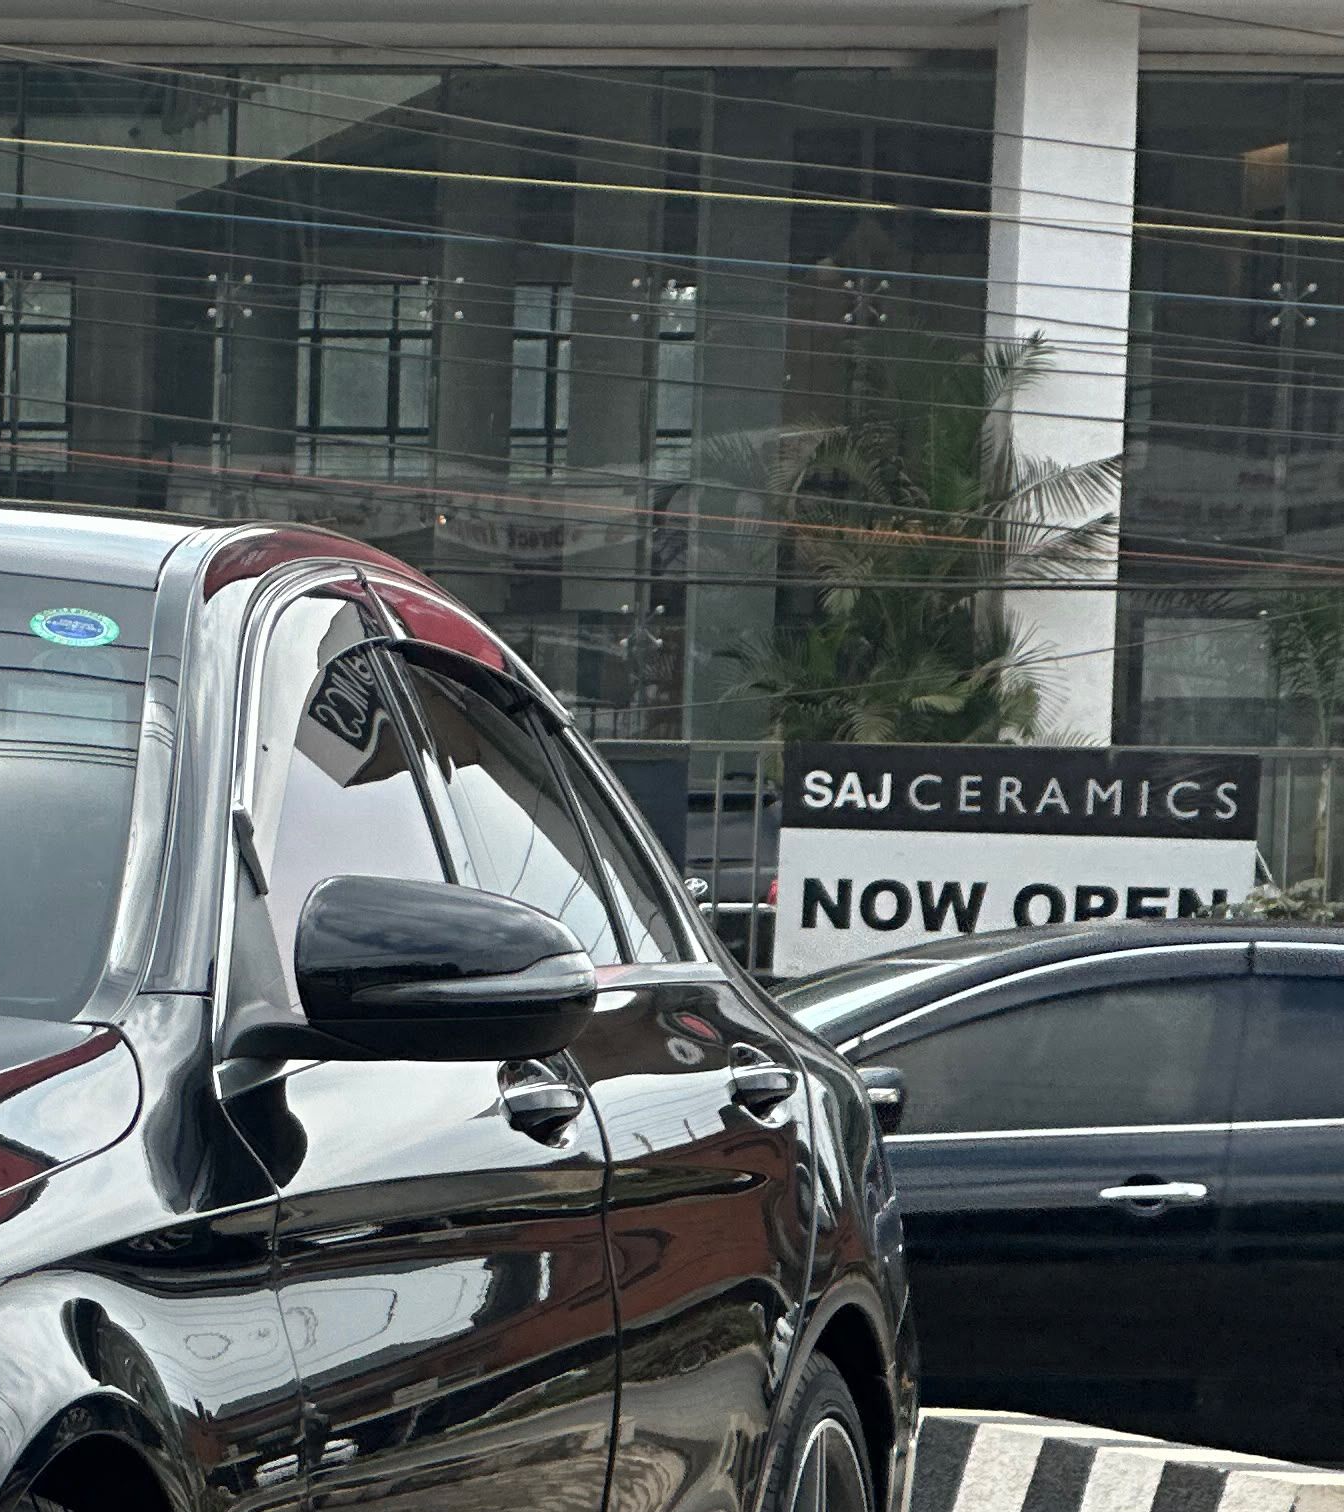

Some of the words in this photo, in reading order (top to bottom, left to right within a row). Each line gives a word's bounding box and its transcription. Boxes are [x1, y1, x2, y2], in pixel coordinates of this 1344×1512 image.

[802, 768, 892, 811] SAJ
[908, 773, 1239, 821] CERAMICS
[800, 877, 988, 933] NOW
